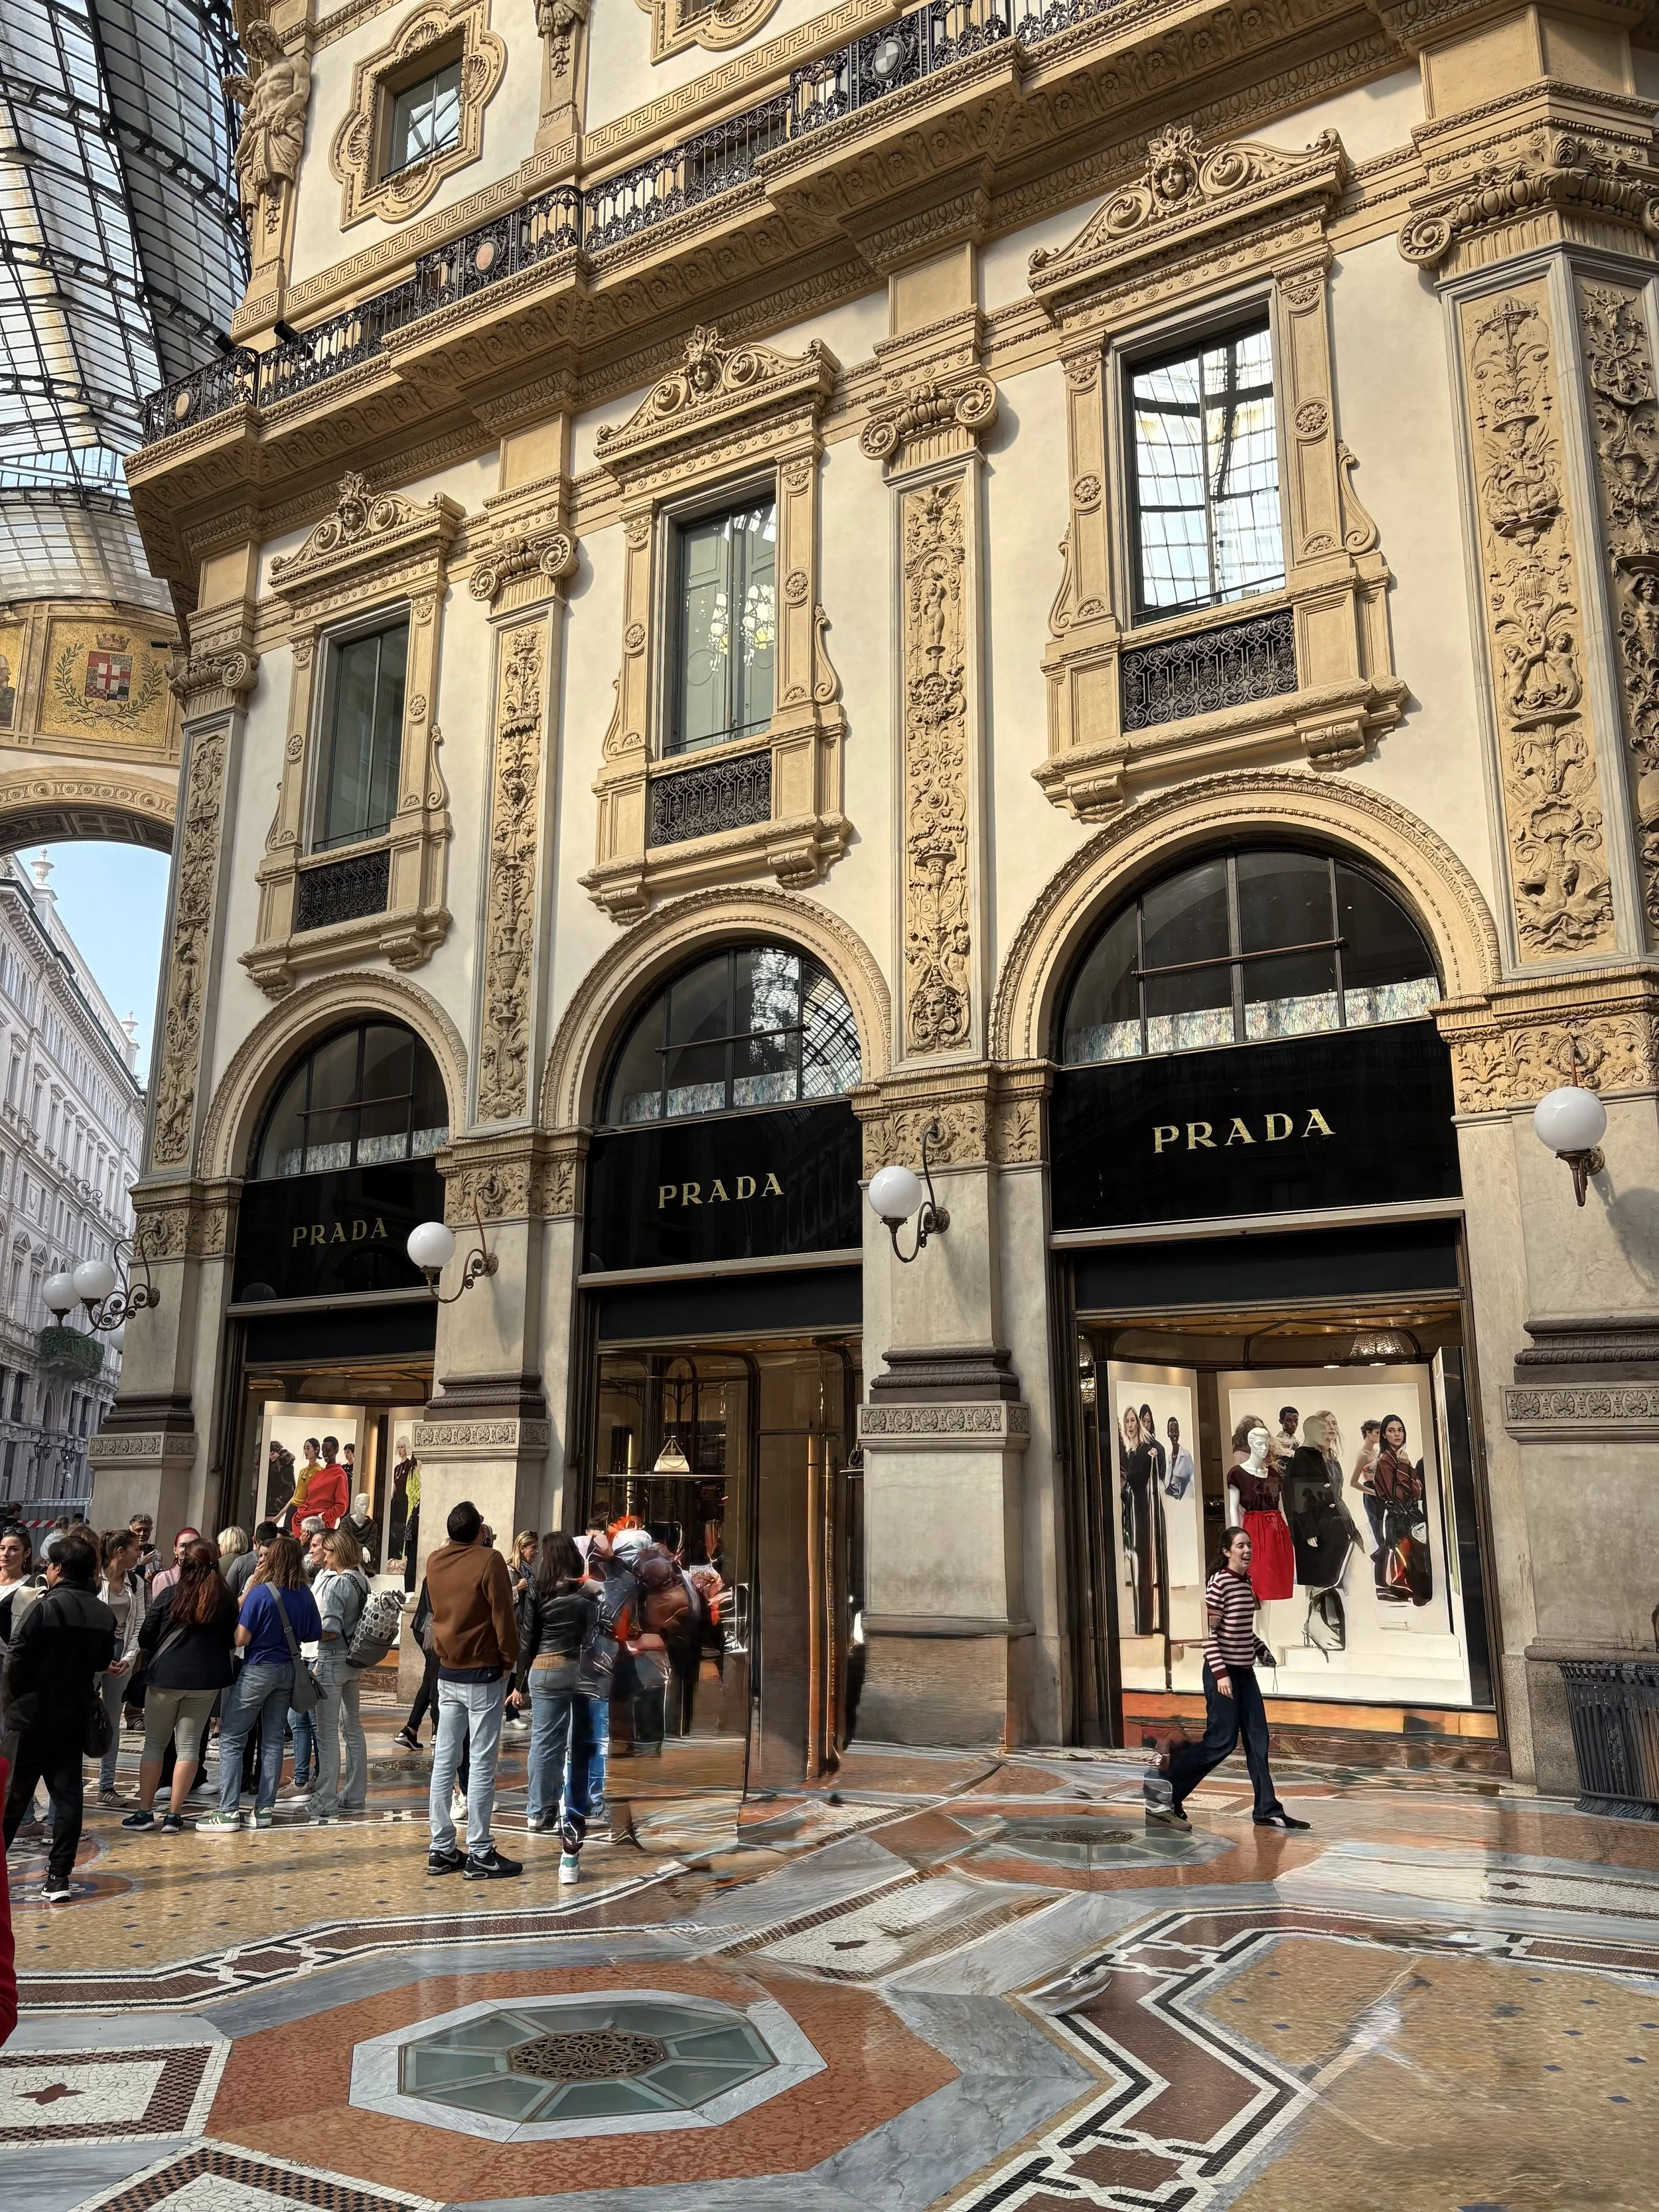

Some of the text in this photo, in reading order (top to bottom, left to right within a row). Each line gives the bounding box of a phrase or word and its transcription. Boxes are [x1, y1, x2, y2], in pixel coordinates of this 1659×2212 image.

[1152, 1108, 1335, 1153] PRADA
[658, 1173, 784, 1209] PRADA
[292, 1217, 388, 1248] PRADA
